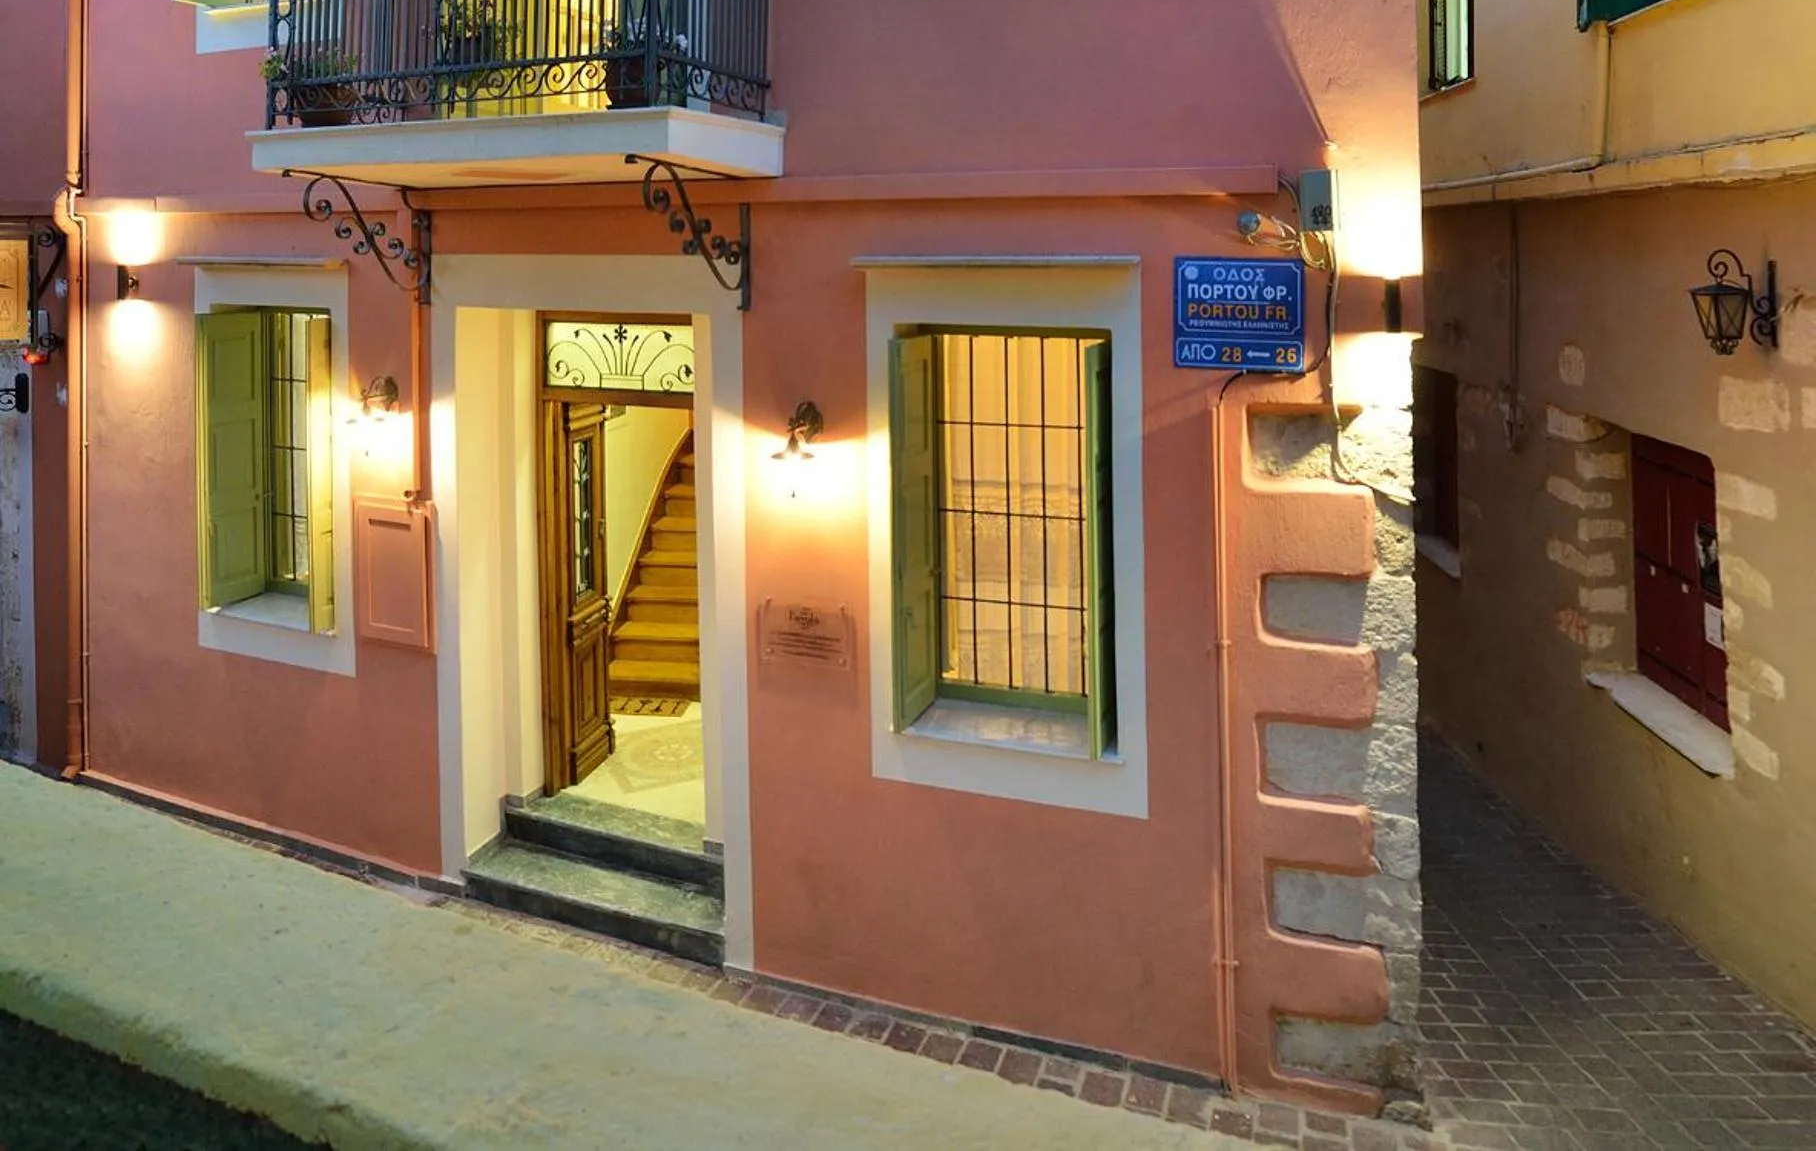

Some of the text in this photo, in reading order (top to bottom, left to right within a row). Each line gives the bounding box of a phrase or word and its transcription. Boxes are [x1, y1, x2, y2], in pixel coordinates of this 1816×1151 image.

[1213, 268, 1264, 282] ΟΔΟΣ
[1187, 284, 1293, 302] ΠΟΡΤΟΥ ΦΡ.
[1187, 303, 1259, 320] PORTOU
[1181, 343, 1297, 364] ΑΠΟ 28 26
